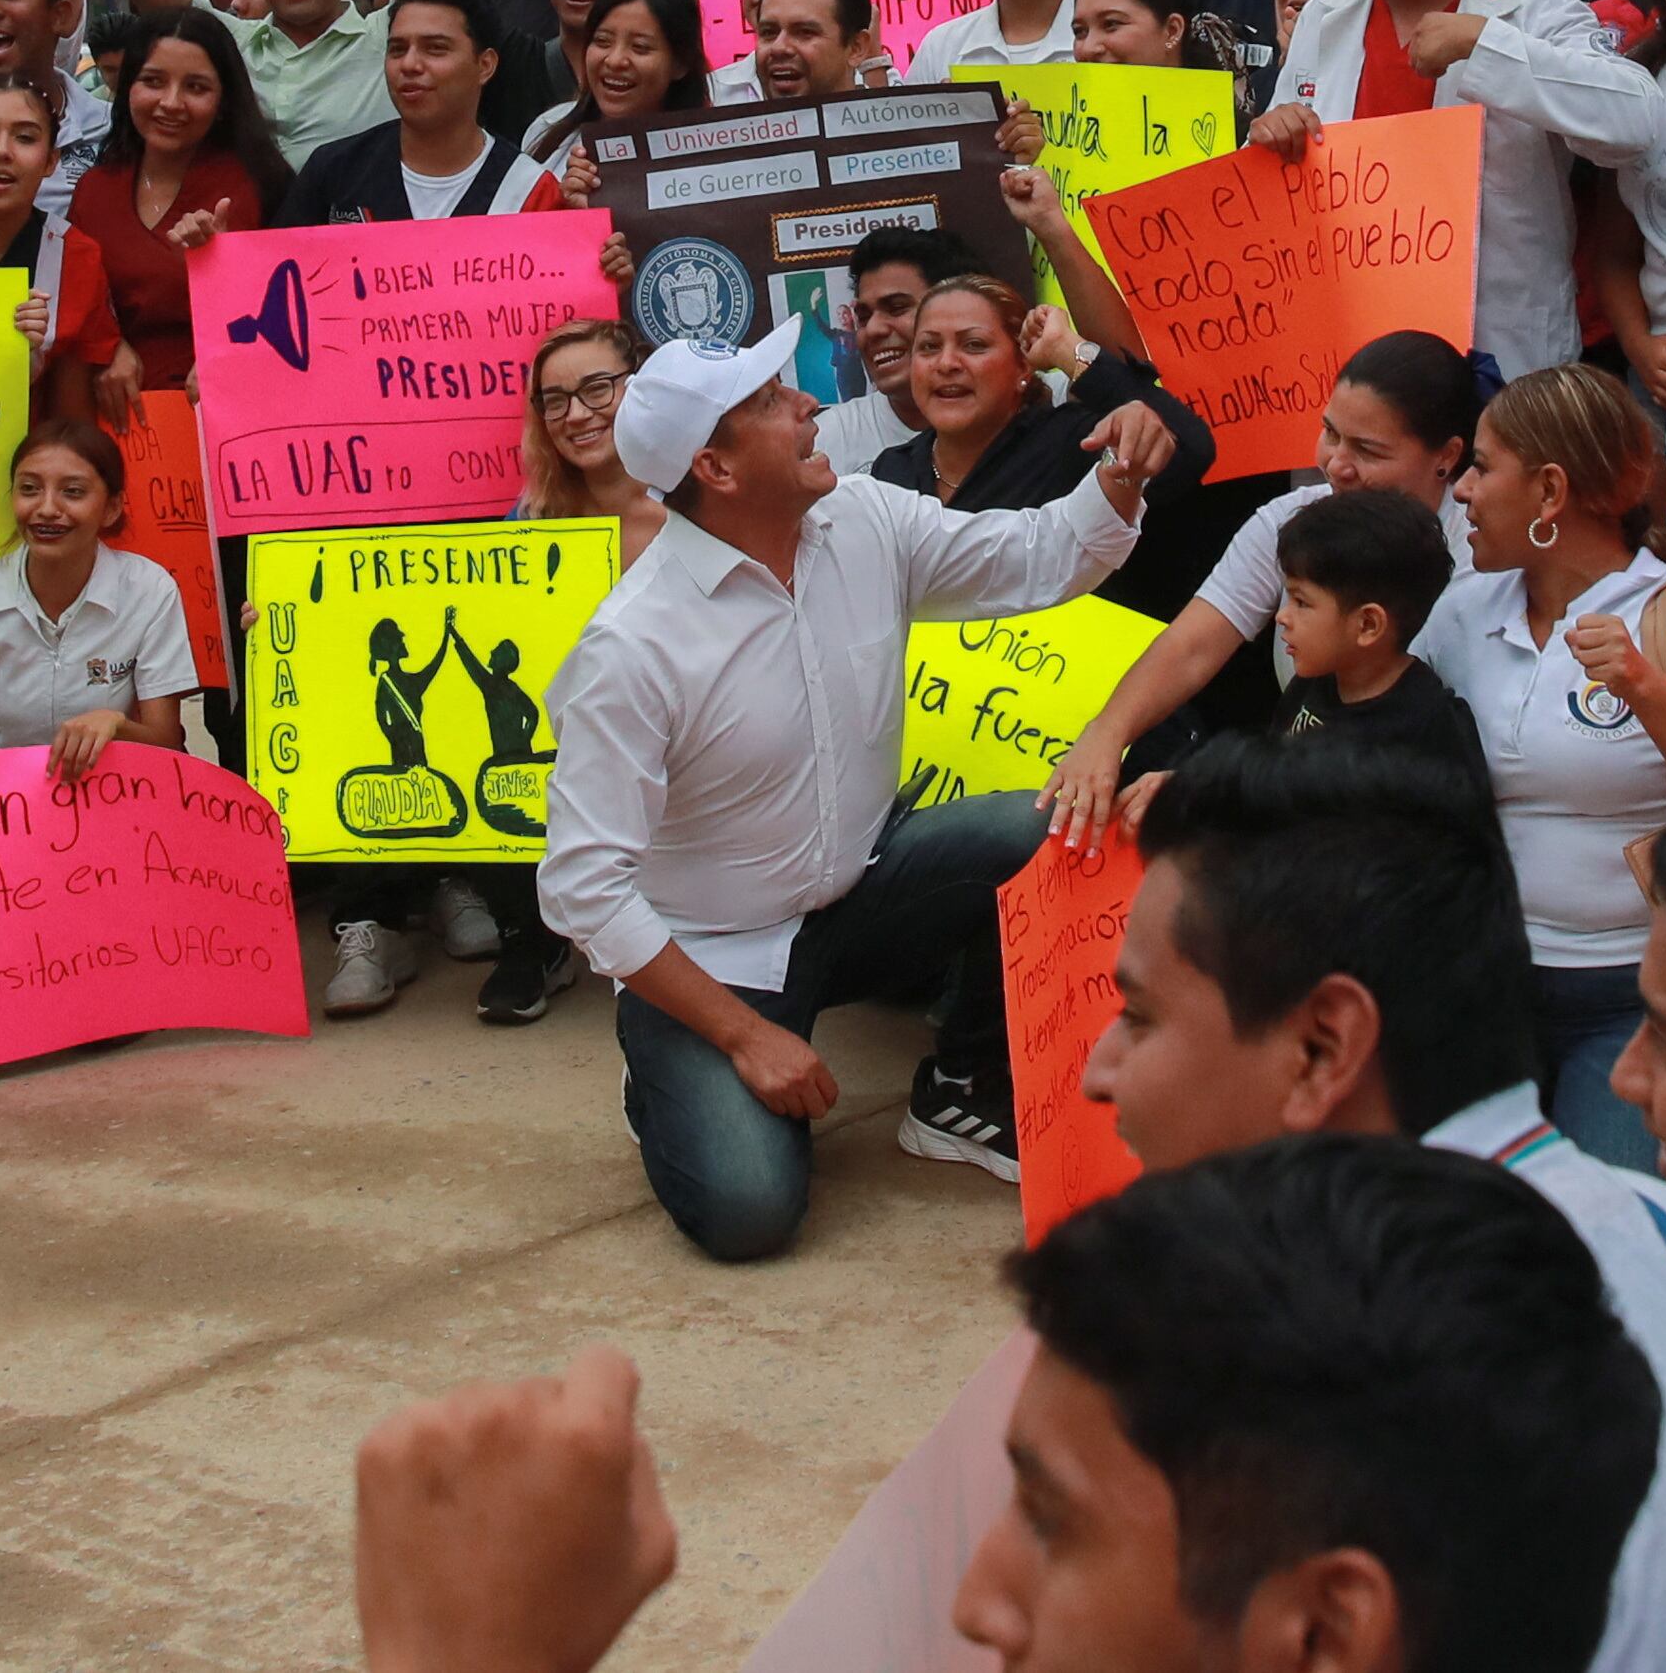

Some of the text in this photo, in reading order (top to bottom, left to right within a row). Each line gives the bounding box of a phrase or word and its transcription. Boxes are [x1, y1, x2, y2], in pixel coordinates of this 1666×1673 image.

[602, 98, 960, 158] La Universidad Autónoma
[1143, 95, 1171, 157] la
[664, 146, 954, 200] de Guerrero Presente:
[1213, 162, 1259, 228] el
[794, 212, 921, 241] Presidenta
[718, 261, 732, 274] DE
[1124, 249, 1233, 311] todo
[1307, 229, 1325, 276] el
[362, 309, 472, 345] PRIMERA
[228, 435, 412, 503] LA UAGro
[909, 661, 949, 714] la
[50, 771, 156, 853] gran
[174, 757, 280, 839] honor
[65, 865, 116, 895] en
